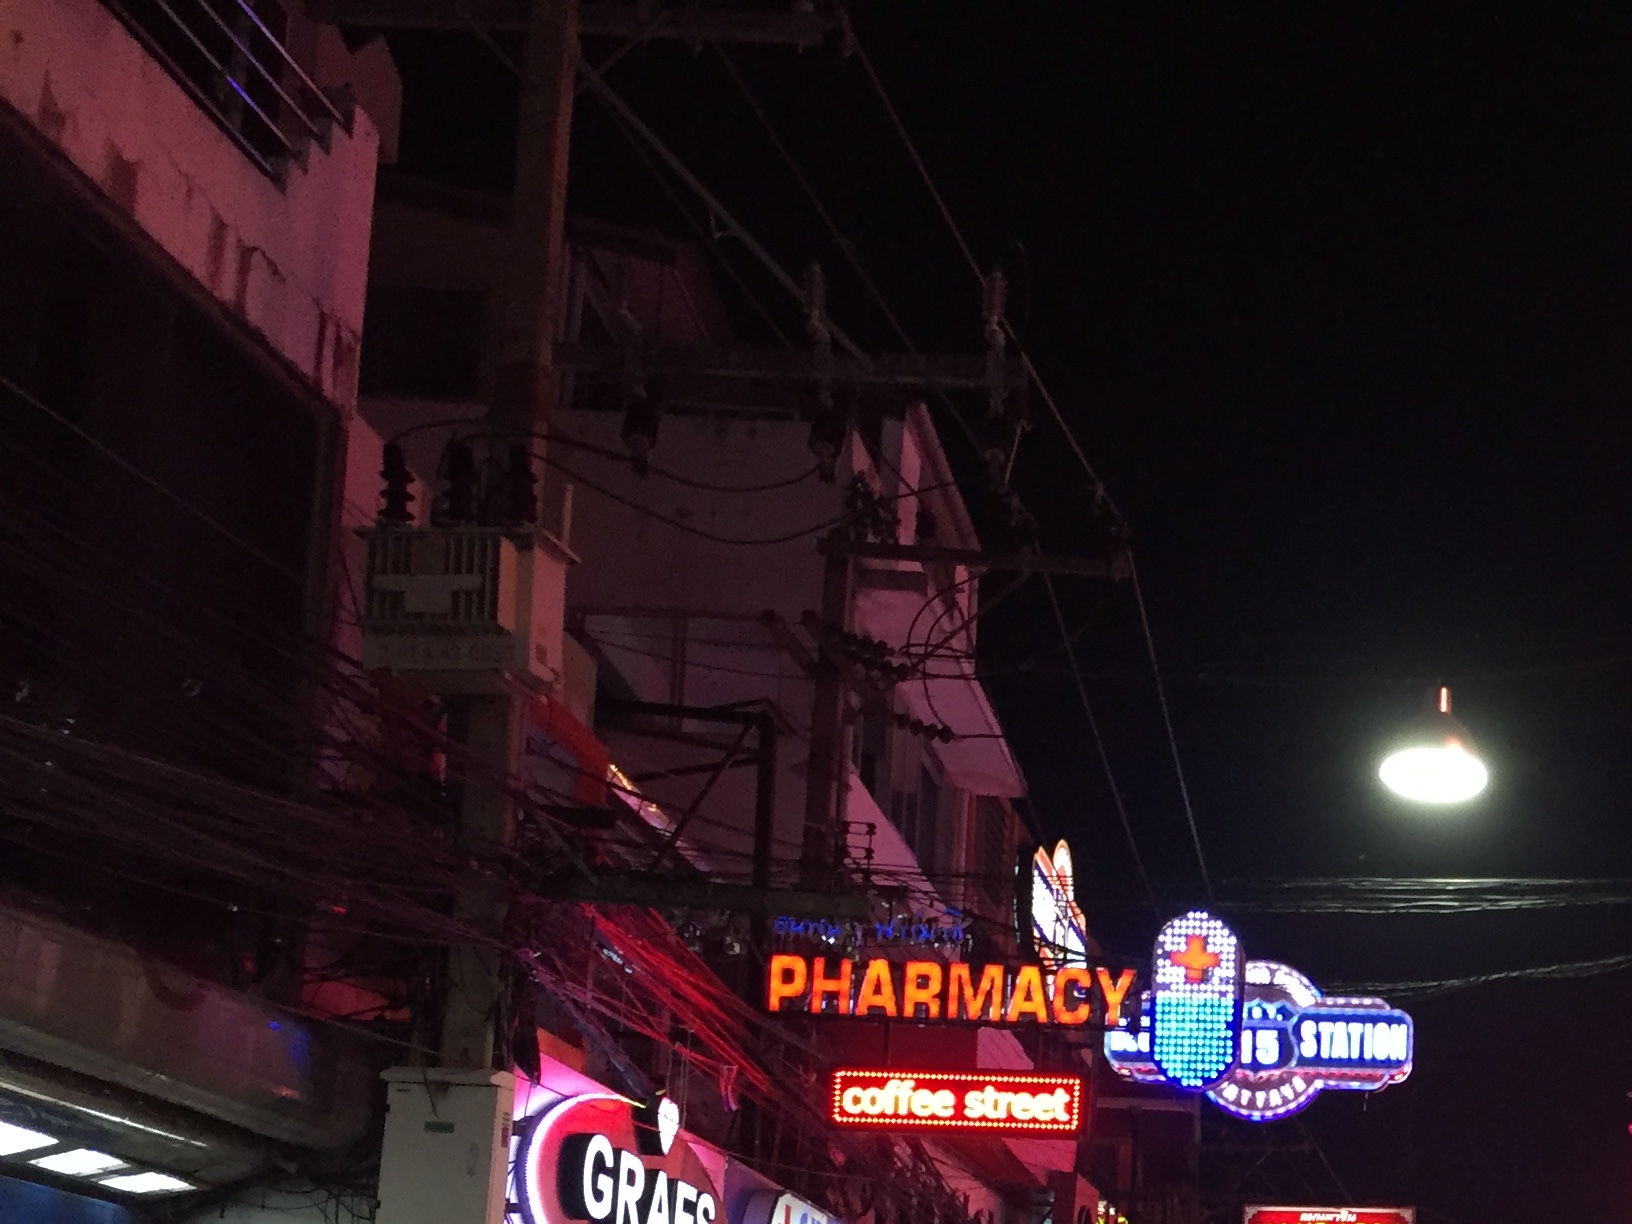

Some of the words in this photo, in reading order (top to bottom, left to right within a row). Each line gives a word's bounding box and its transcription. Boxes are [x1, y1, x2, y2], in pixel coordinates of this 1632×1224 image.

[767, 953, 1138, 1026] PHARMACY
[1300, 1020, 1408, 1061] STATION
[843, 1080, 956, 1116] coffee
[963, 1083, 1071, 1121] street
[1220, 1075, 1307, 1108] ATTAYA
